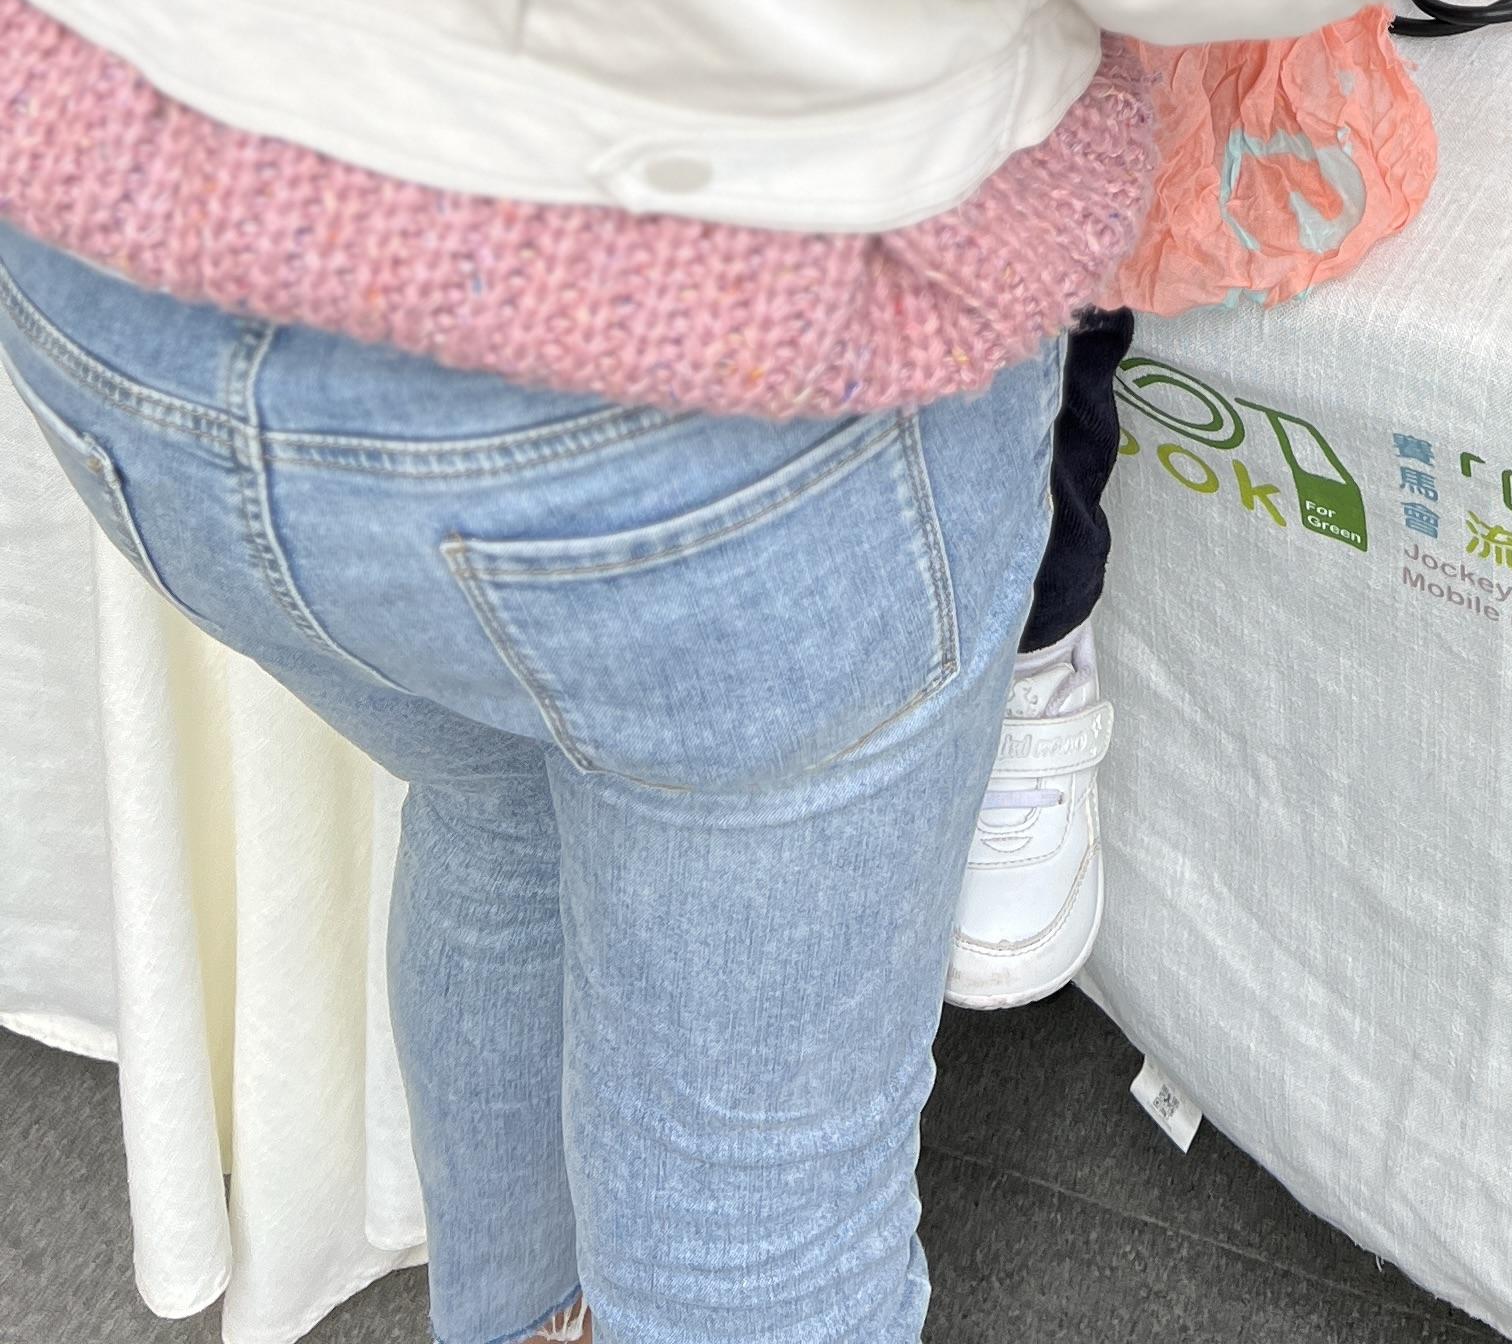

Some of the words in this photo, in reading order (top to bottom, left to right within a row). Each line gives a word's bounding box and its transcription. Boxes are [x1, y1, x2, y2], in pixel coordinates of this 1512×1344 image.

[1393, 432, 1439, 539] 賽馬會
[1305, 499, 1337, 519] For
[1306, 515, 1362, 544] Green
[1402, 566, 1500, 622] Mobile
